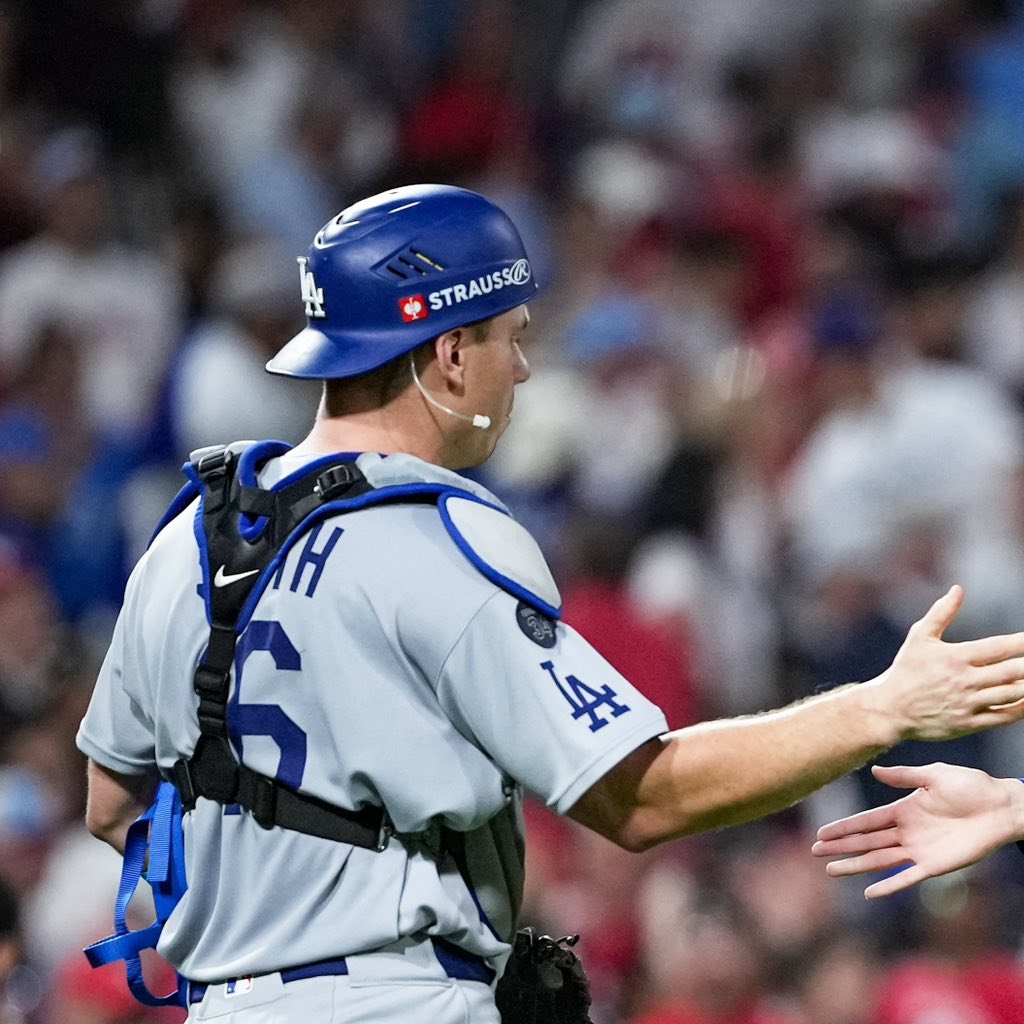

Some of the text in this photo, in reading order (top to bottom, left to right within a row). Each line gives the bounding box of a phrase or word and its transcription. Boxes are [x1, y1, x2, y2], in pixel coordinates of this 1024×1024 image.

[296, 255, 325, 317] LA
[429, 269, 512, 310] STRAUSS
[539, 660, 631, 733] LA
